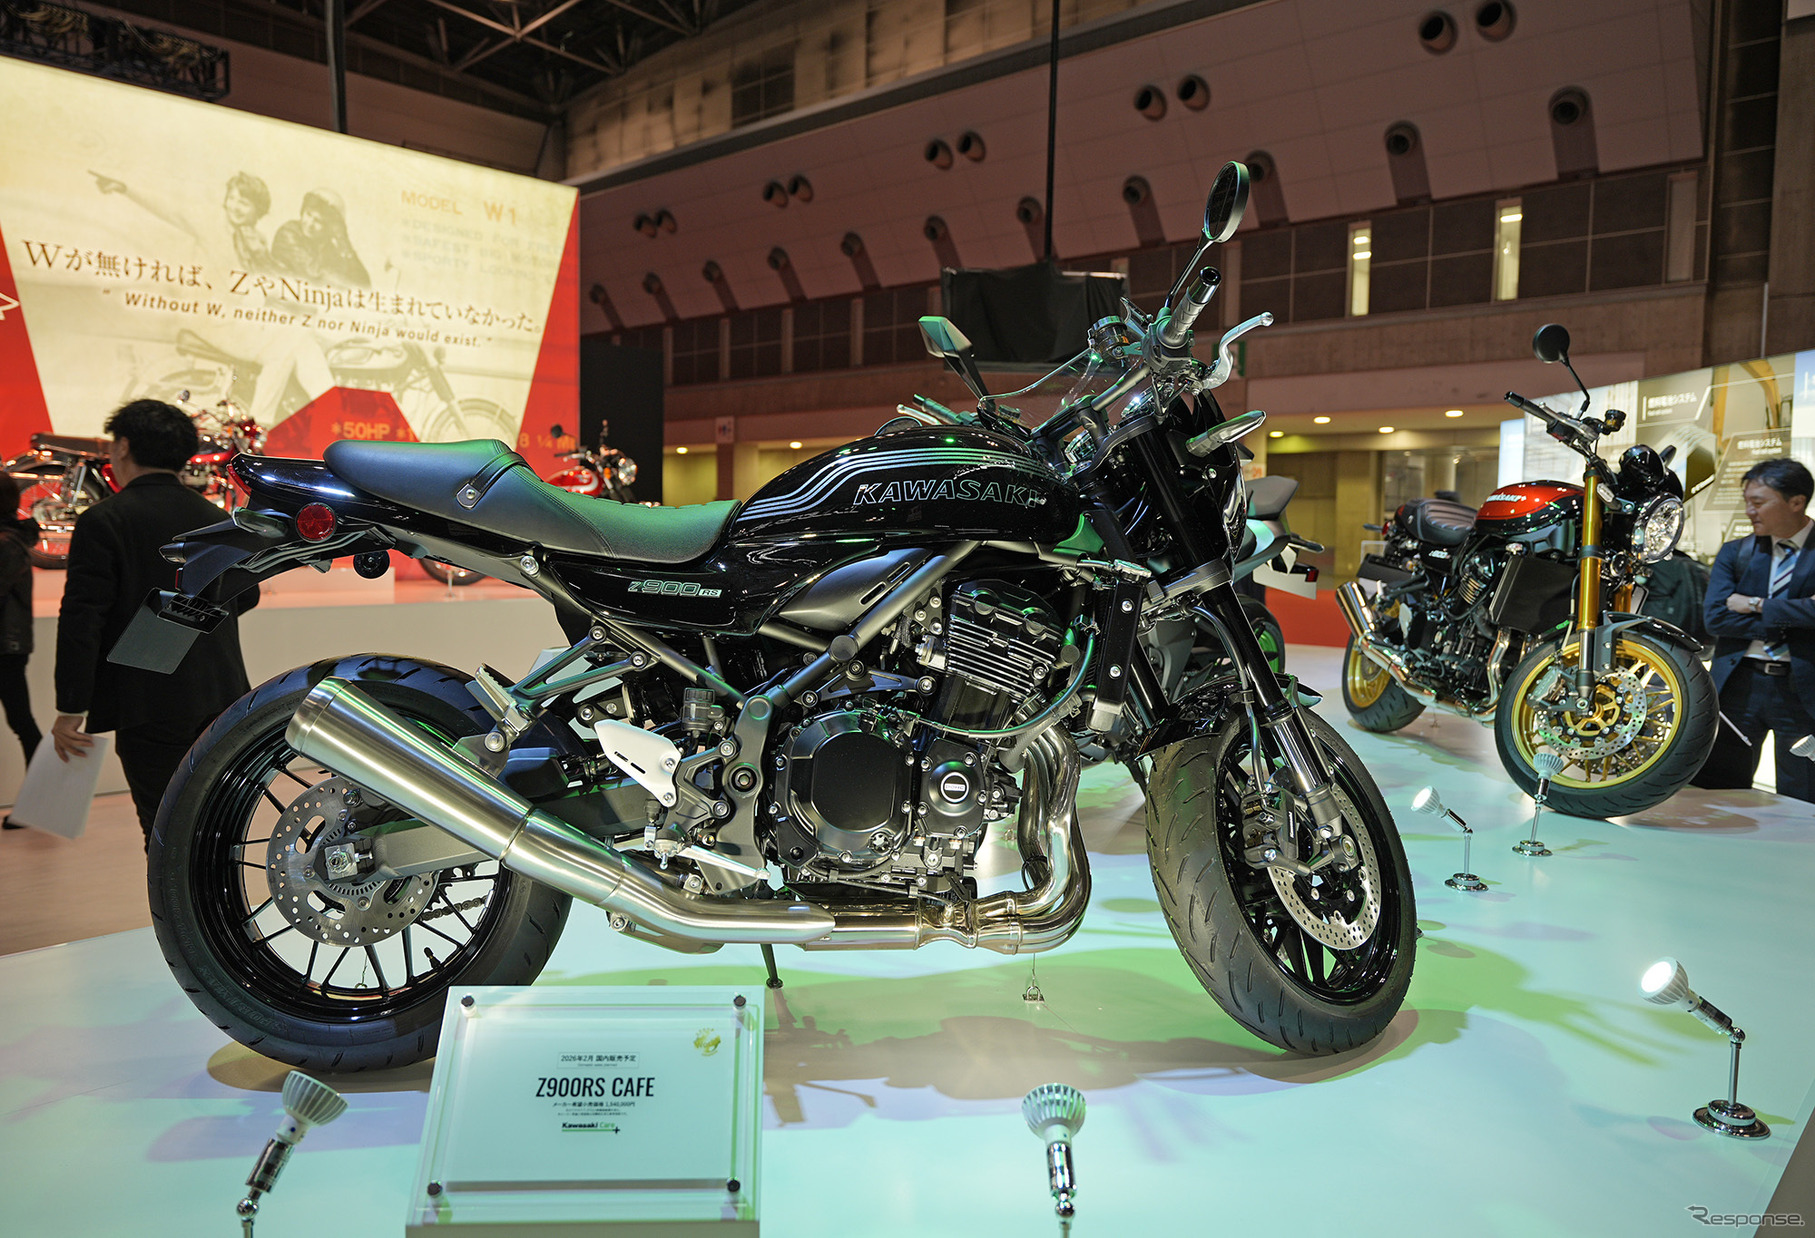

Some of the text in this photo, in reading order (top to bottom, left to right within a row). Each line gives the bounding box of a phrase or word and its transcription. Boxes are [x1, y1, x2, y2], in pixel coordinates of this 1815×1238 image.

[401, 189, 463, 216] MODEL
[125, 292, 199, 315] Without
[233, 307, 295, 326] neither
[301, 314, 312, 327] Z
[317, 318, 344, 331] nor
[350, 320, 390, 339] Ninja
[396, 327, 439, 343] would
[853, 479, 1038, 508] KAWASAKI
[535, 1077, 656, 1098] Z900RS CAFE
[561, 1121, 599, 1129] Kawasaki
